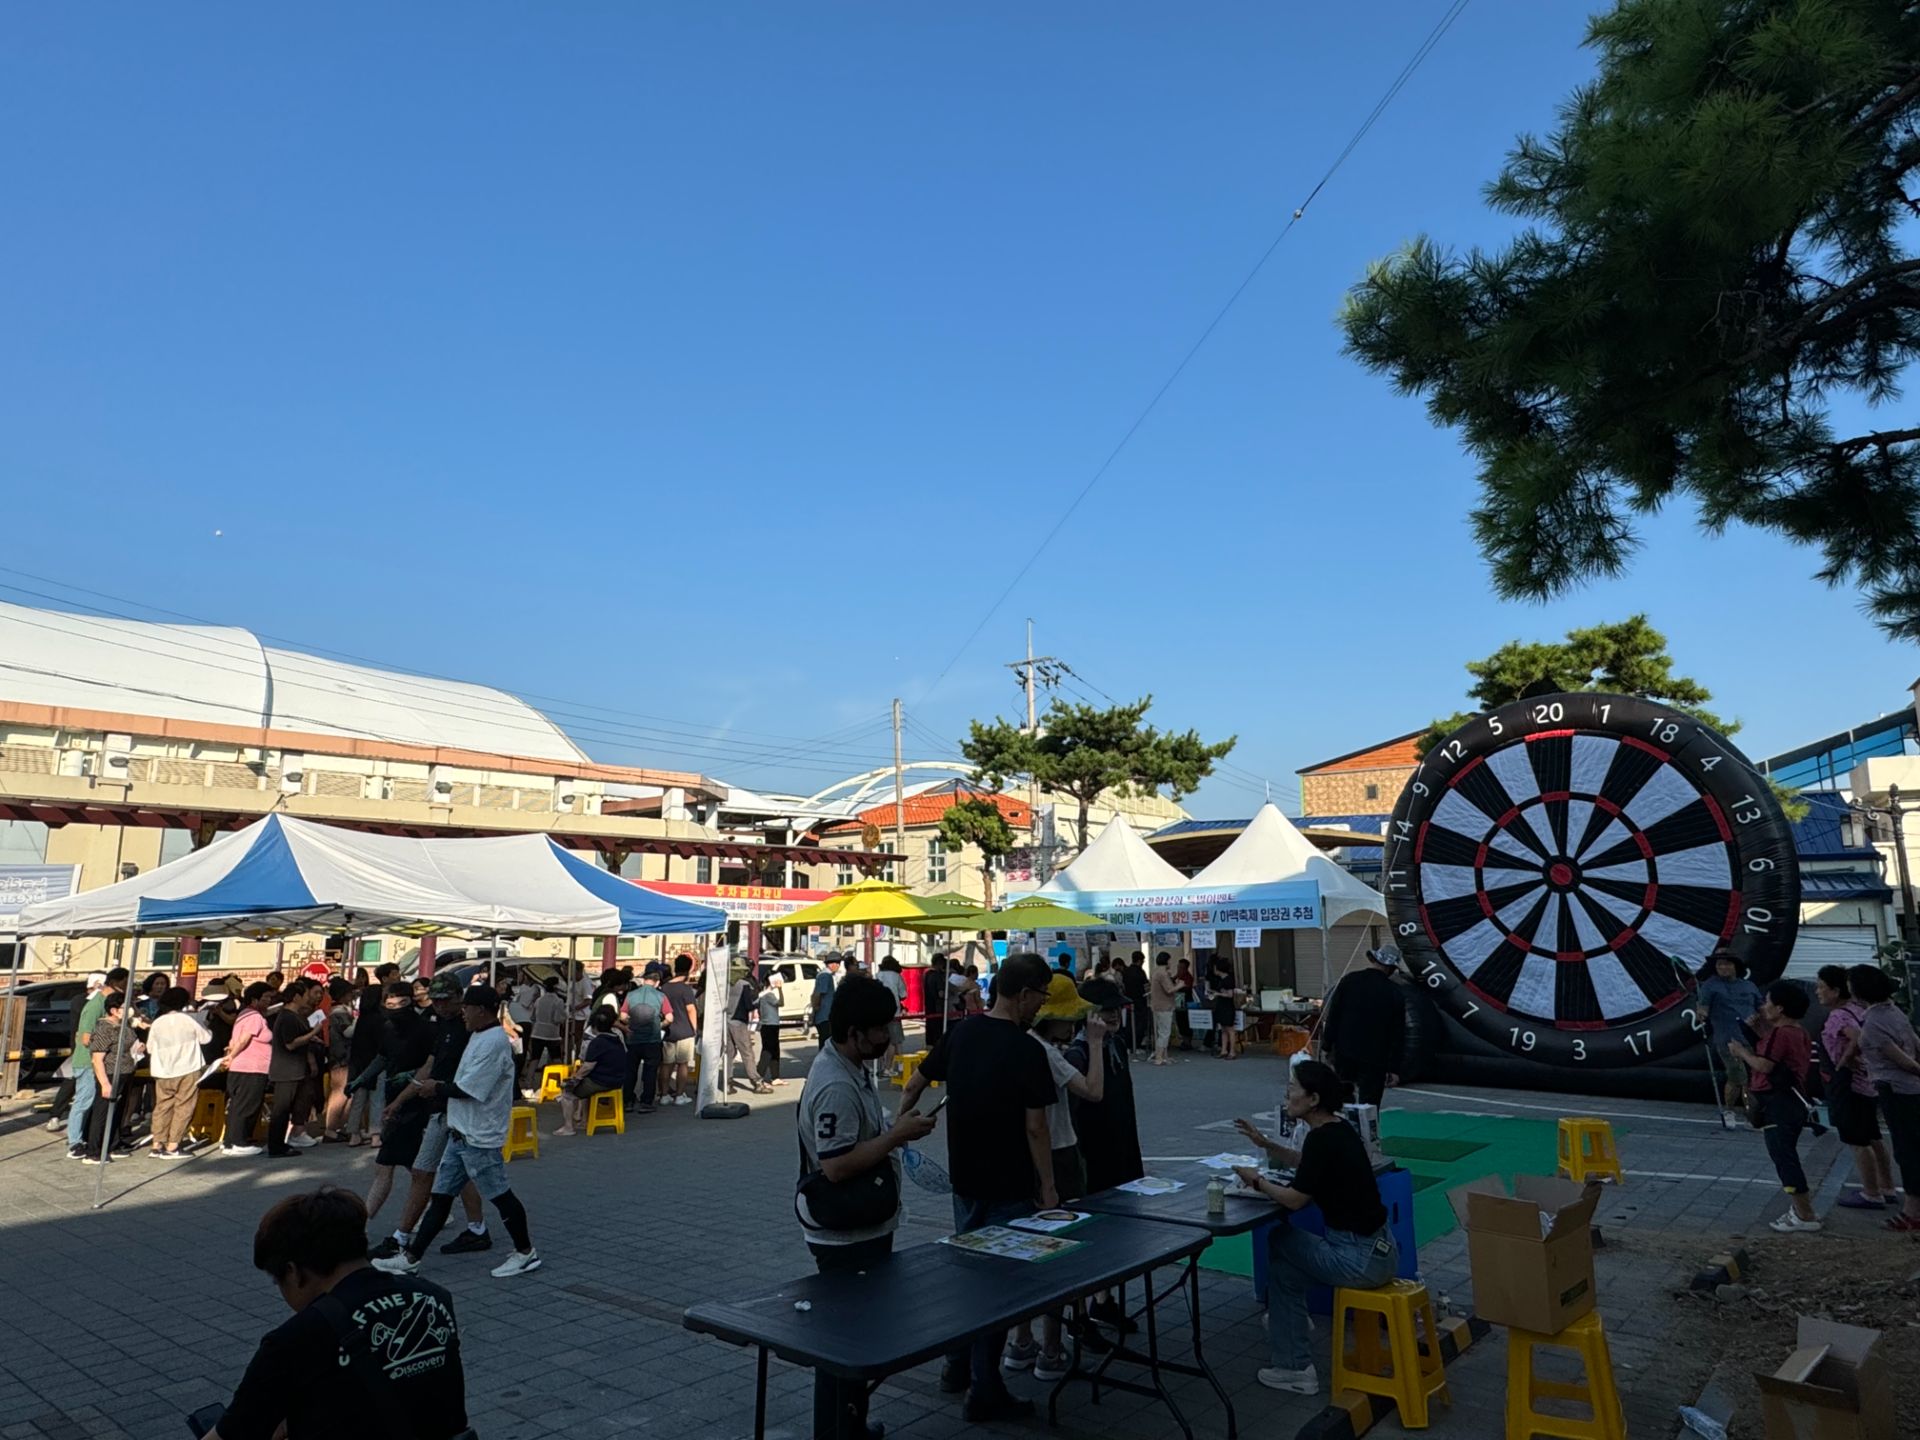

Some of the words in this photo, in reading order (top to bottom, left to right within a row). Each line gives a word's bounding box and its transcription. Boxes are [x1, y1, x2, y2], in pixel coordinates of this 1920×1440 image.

[1536, 702, 1564, 724] 20
[1601, 703, 1611, 724] 1
[1488, 716, 1503, 735] 5
[1651, 717, 1679, 742] 18
[1440, 740, 1467, 763] 12
[1700, 755, 1722, 772] 4
[1412, 781, 1429, 797] 9
[1731, 794, 1761, 824] 13
[1392, 820, 1414, 843] 14
[1389, 870, 1407, 891] 11
[1110, 912, 1134, 925] 페이백
[1172, 911, 1189, 924] 할인
[1192, 910, 1210, 923] 쿠폰
[1260, 907, 1290, 921] 입장권
[1293, 906, 1313, 920] 추첨
[1744, 907, 1772, 935] 10
[1399, 921, 1417, 936] 8
[1421, 960, 1447, 988] 16
[1462, 999, 1480, 1019] 7
[1681, 1008, 1703, 1031] 2
[1509, 1026, 1536, 1051] 19
[1573, 1039, 1586, 1060] 3
[1624, 1030, 1653, 1056] 17
[818, 1112, 838, 1139] 3
[364, 1293, 406, 1315] THE
[393, 1353, 446, 1378] Discovery
